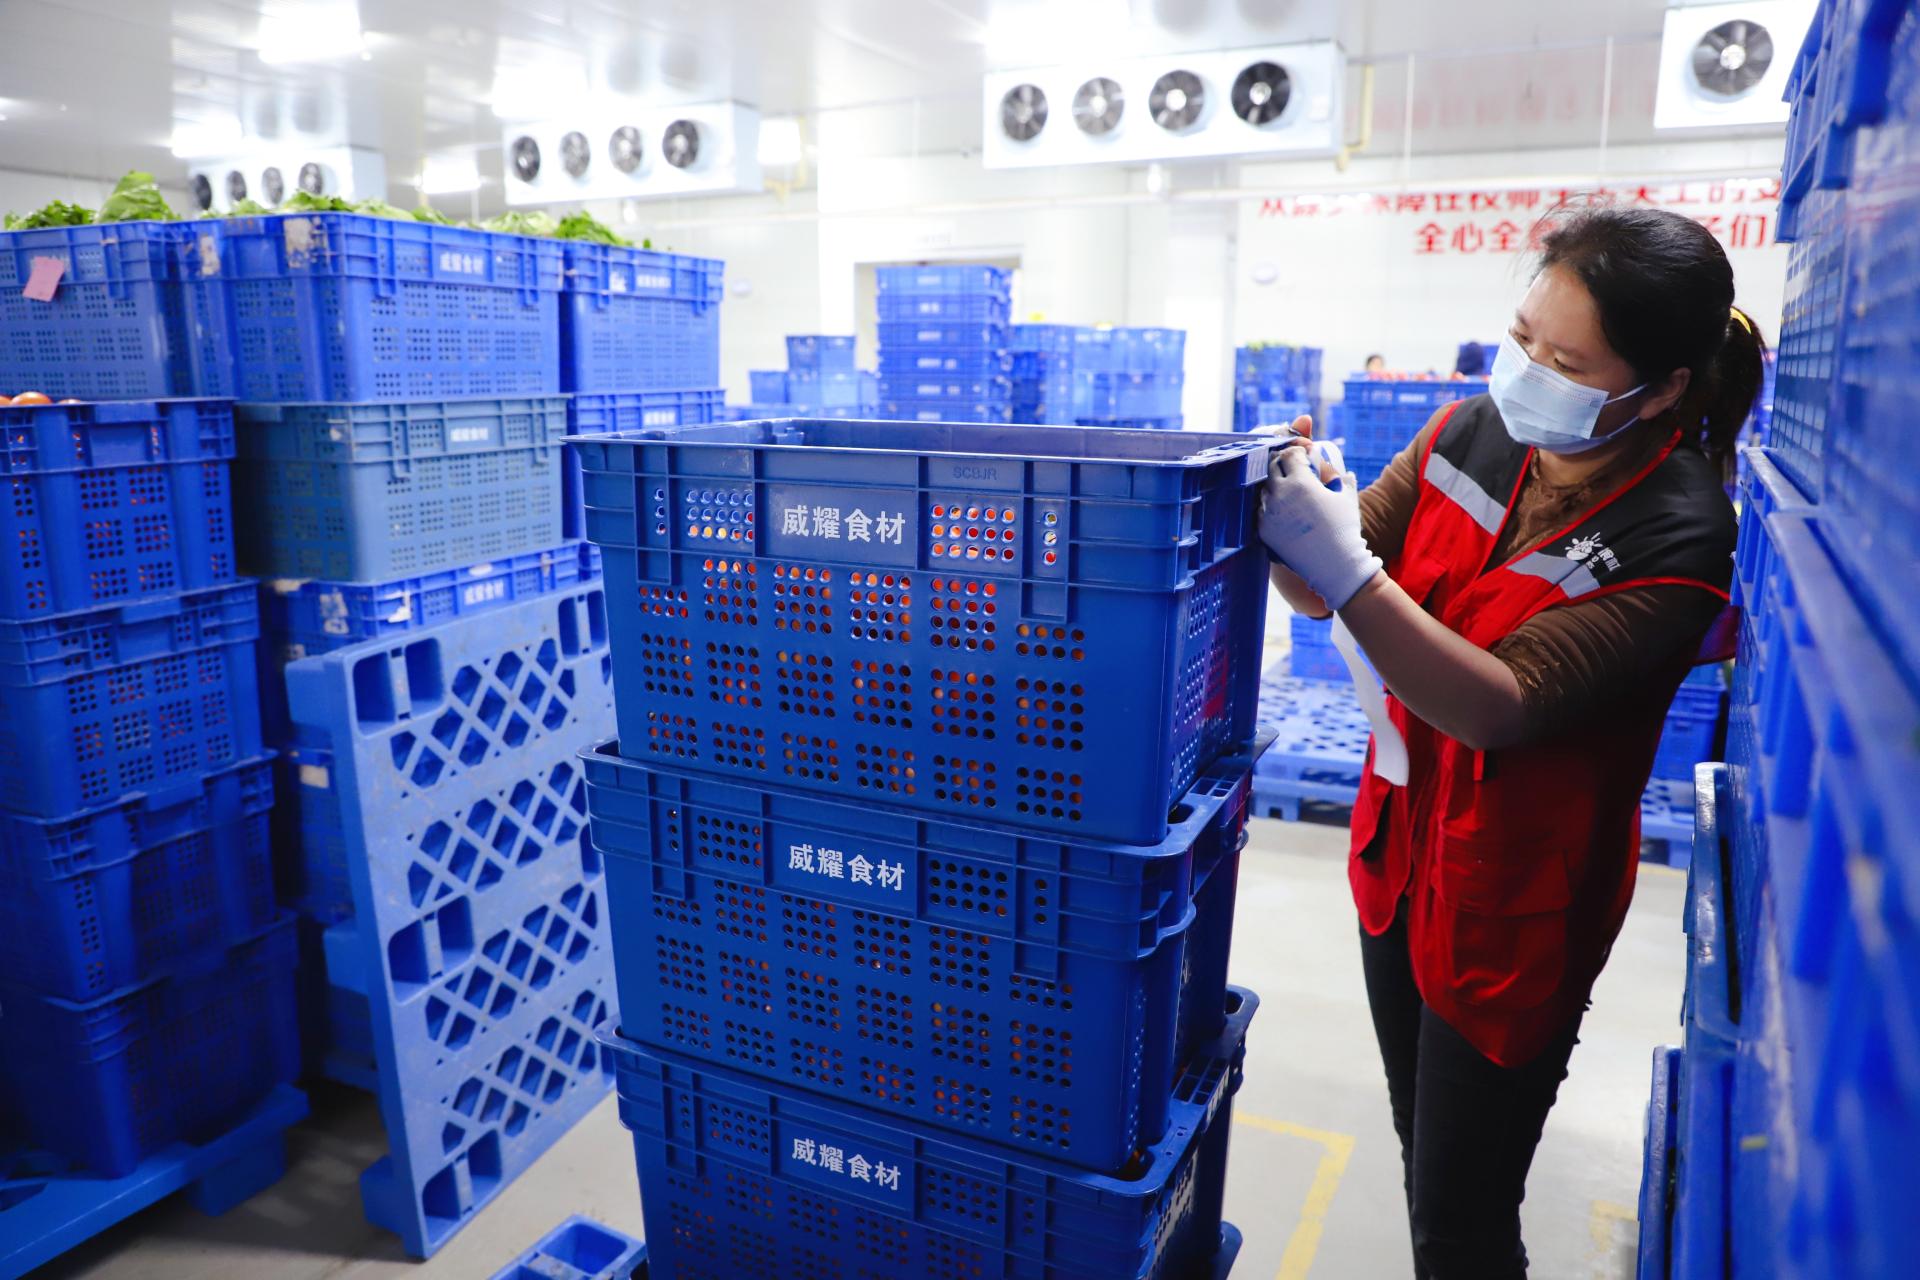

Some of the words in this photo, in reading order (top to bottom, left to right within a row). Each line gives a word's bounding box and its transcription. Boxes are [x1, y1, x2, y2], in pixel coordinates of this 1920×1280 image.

[781, 504, 906, 545] 威耀食材
[788, 843, 905, 891] 威耀食材
[791, 1138, 901, 1191] 威耀食材
